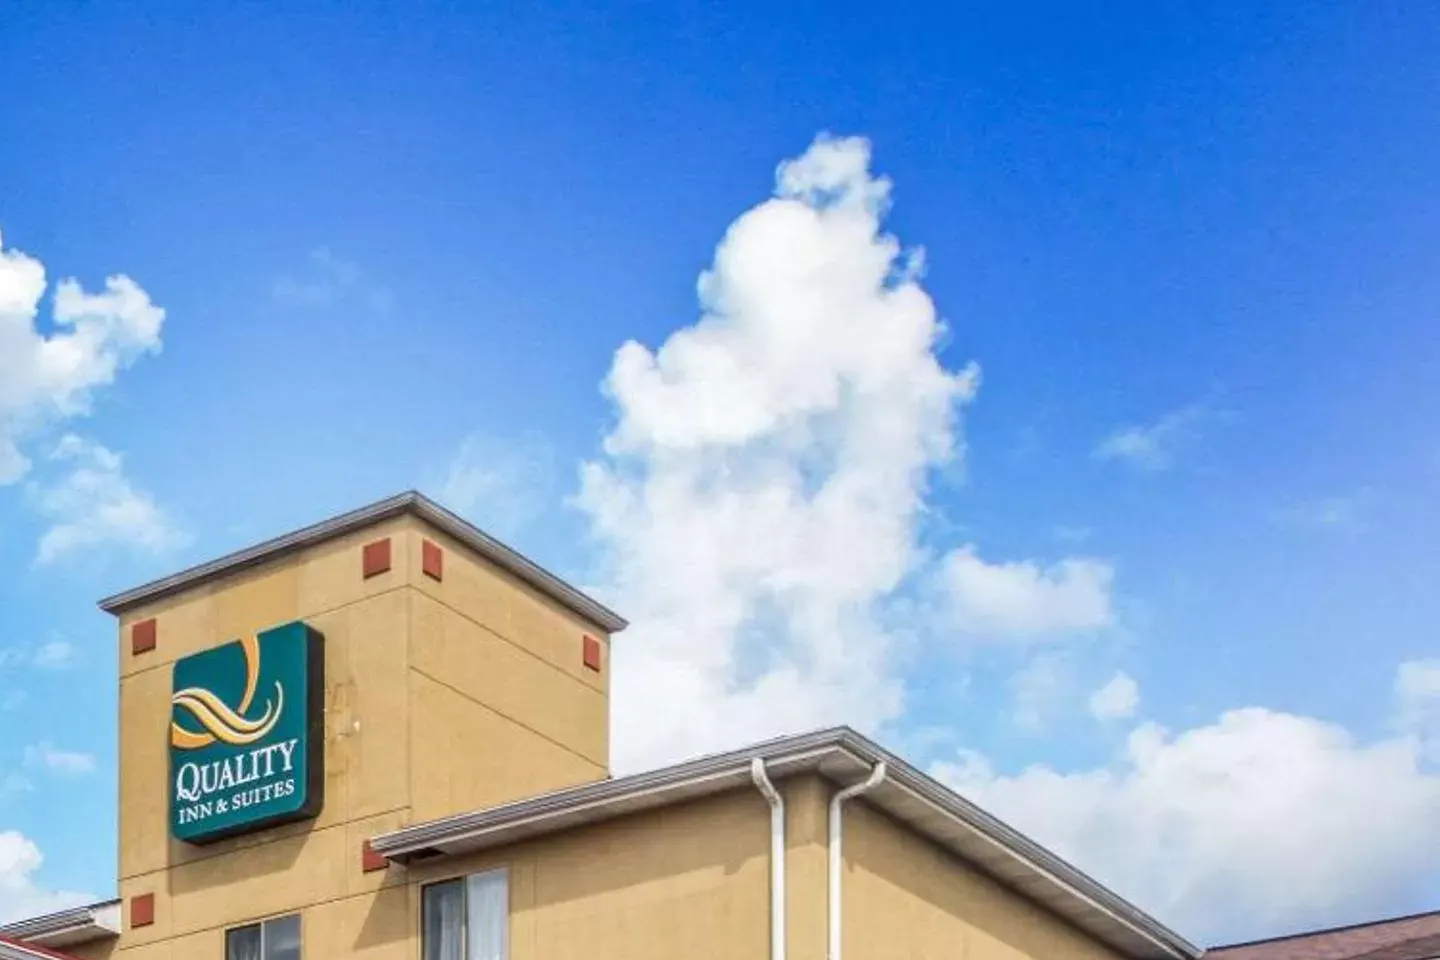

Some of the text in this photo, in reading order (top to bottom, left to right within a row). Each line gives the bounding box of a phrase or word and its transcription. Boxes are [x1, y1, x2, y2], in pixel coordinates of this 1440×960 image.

[176, 738, 298, 801] QUALITY
[179, 778, 295, 824] INN & SUITES
